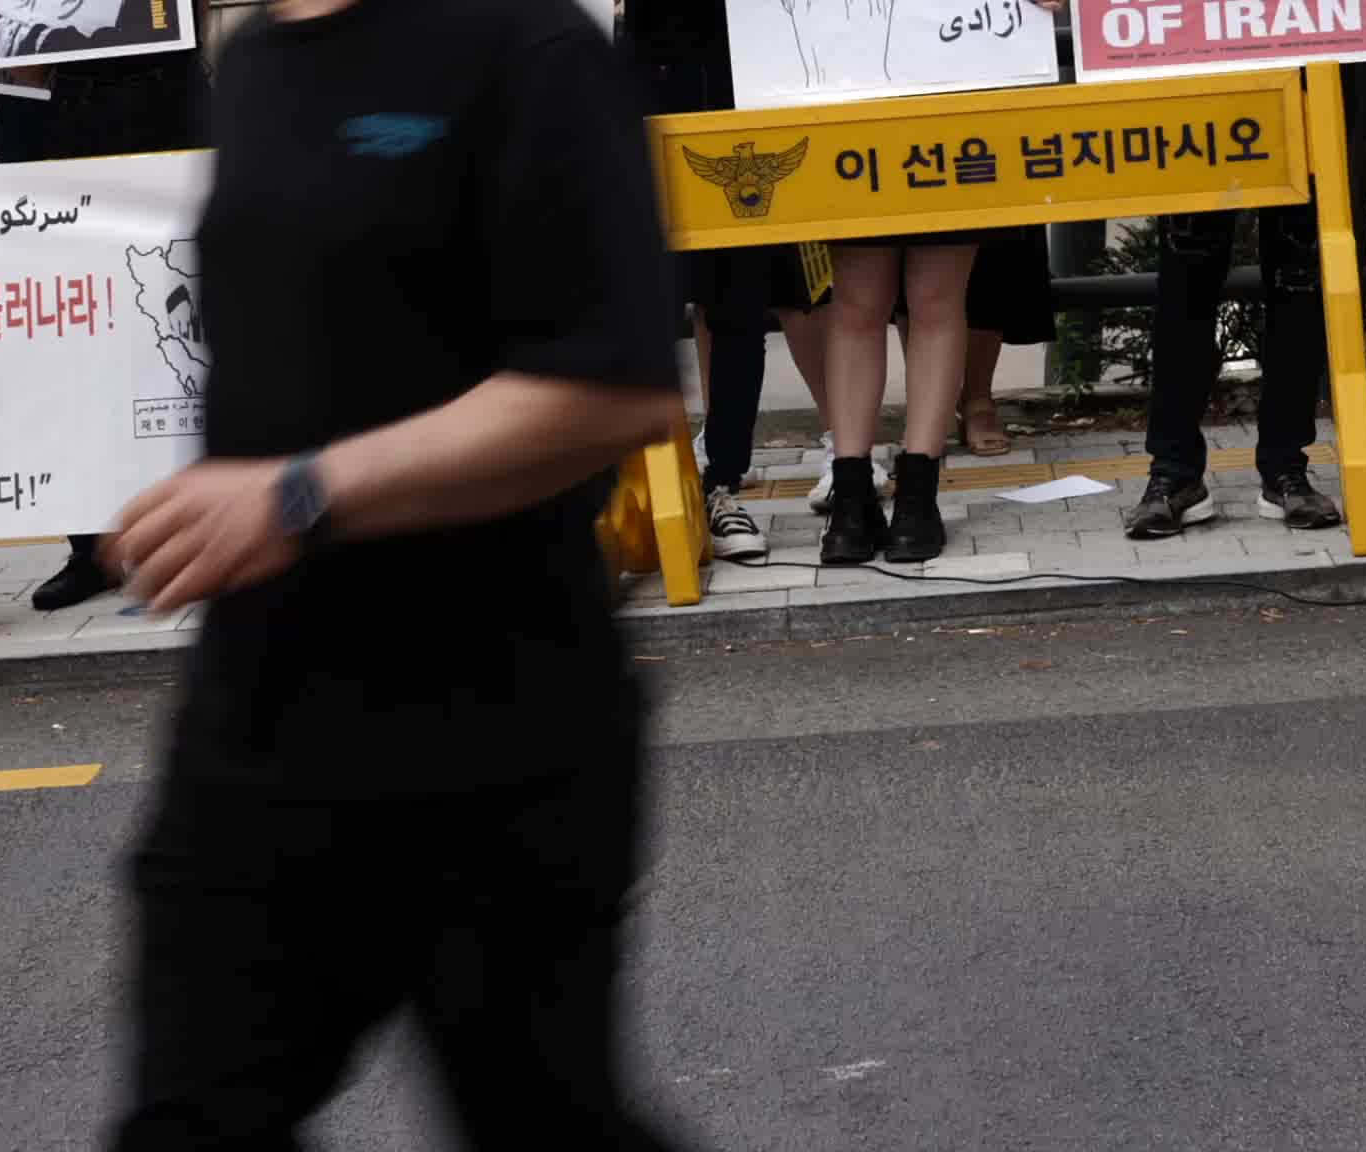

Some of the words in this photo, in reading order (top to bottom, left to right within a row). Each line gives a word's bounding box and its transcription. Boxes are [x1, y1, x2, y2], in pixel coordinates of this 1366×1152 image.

[1102, 5, 1183, 48] OF
[836, 149, 879, 191] 이
[902, 138, 997, 188] 선을
[1020, 117, 1270, 179] 넘지마시오
